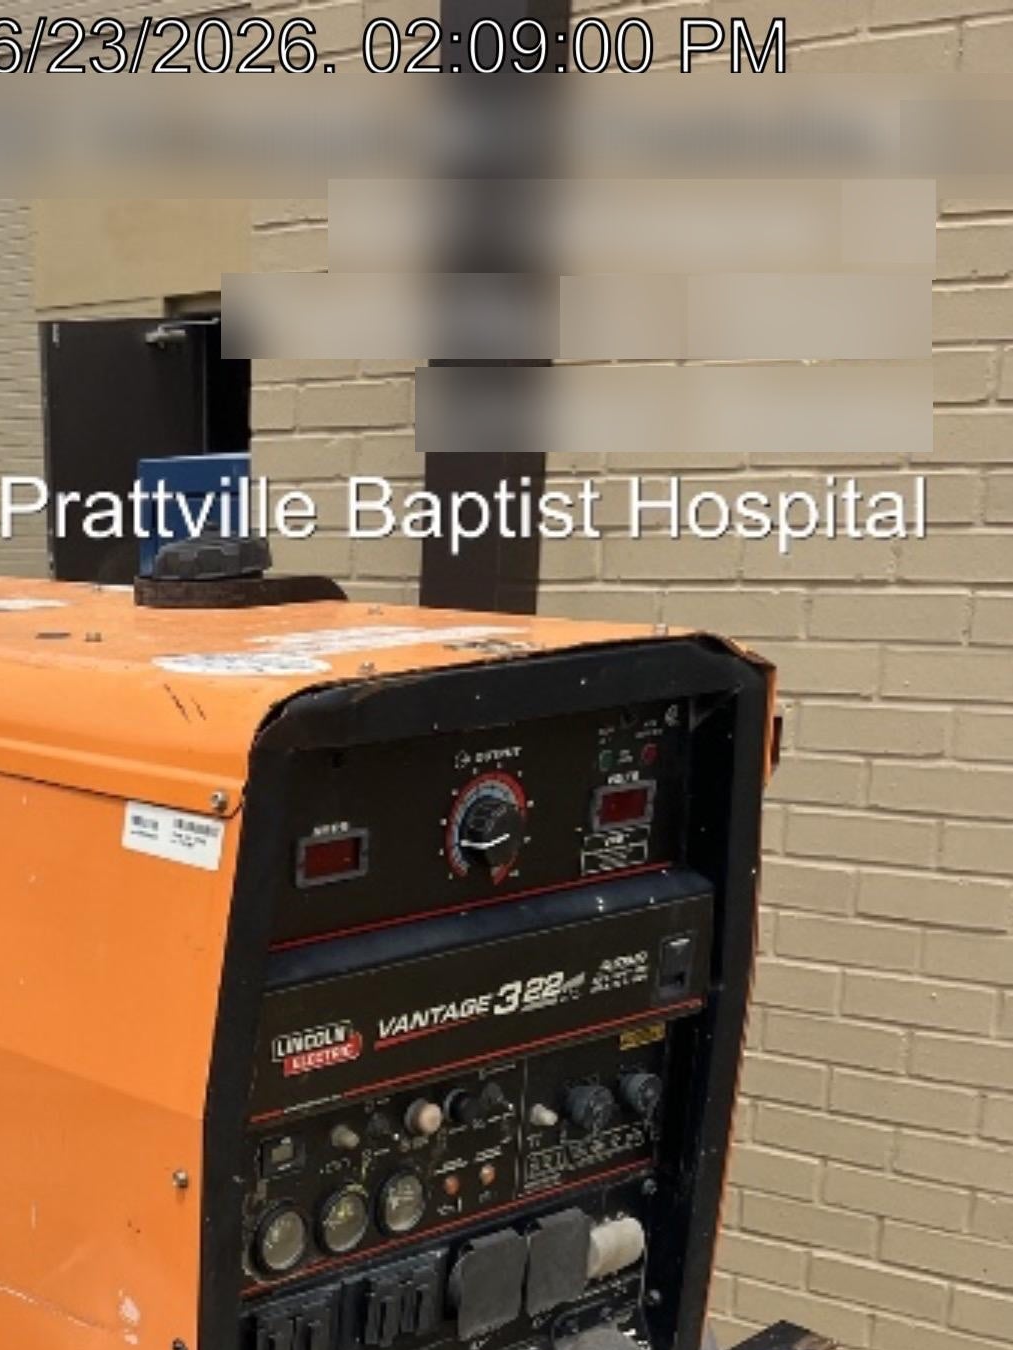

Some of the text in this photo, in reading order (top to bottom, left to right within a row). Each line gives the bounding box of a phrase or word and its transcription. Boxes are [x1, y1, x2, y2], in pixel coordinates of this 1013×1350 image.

[377, 992, 493, 1039] VANTAGE
[493, 971, 565, 1017] 322
[277, 1025, 346, 1057] LINCOLN
[292, 1041, 352, 1069] ELECTRIC
